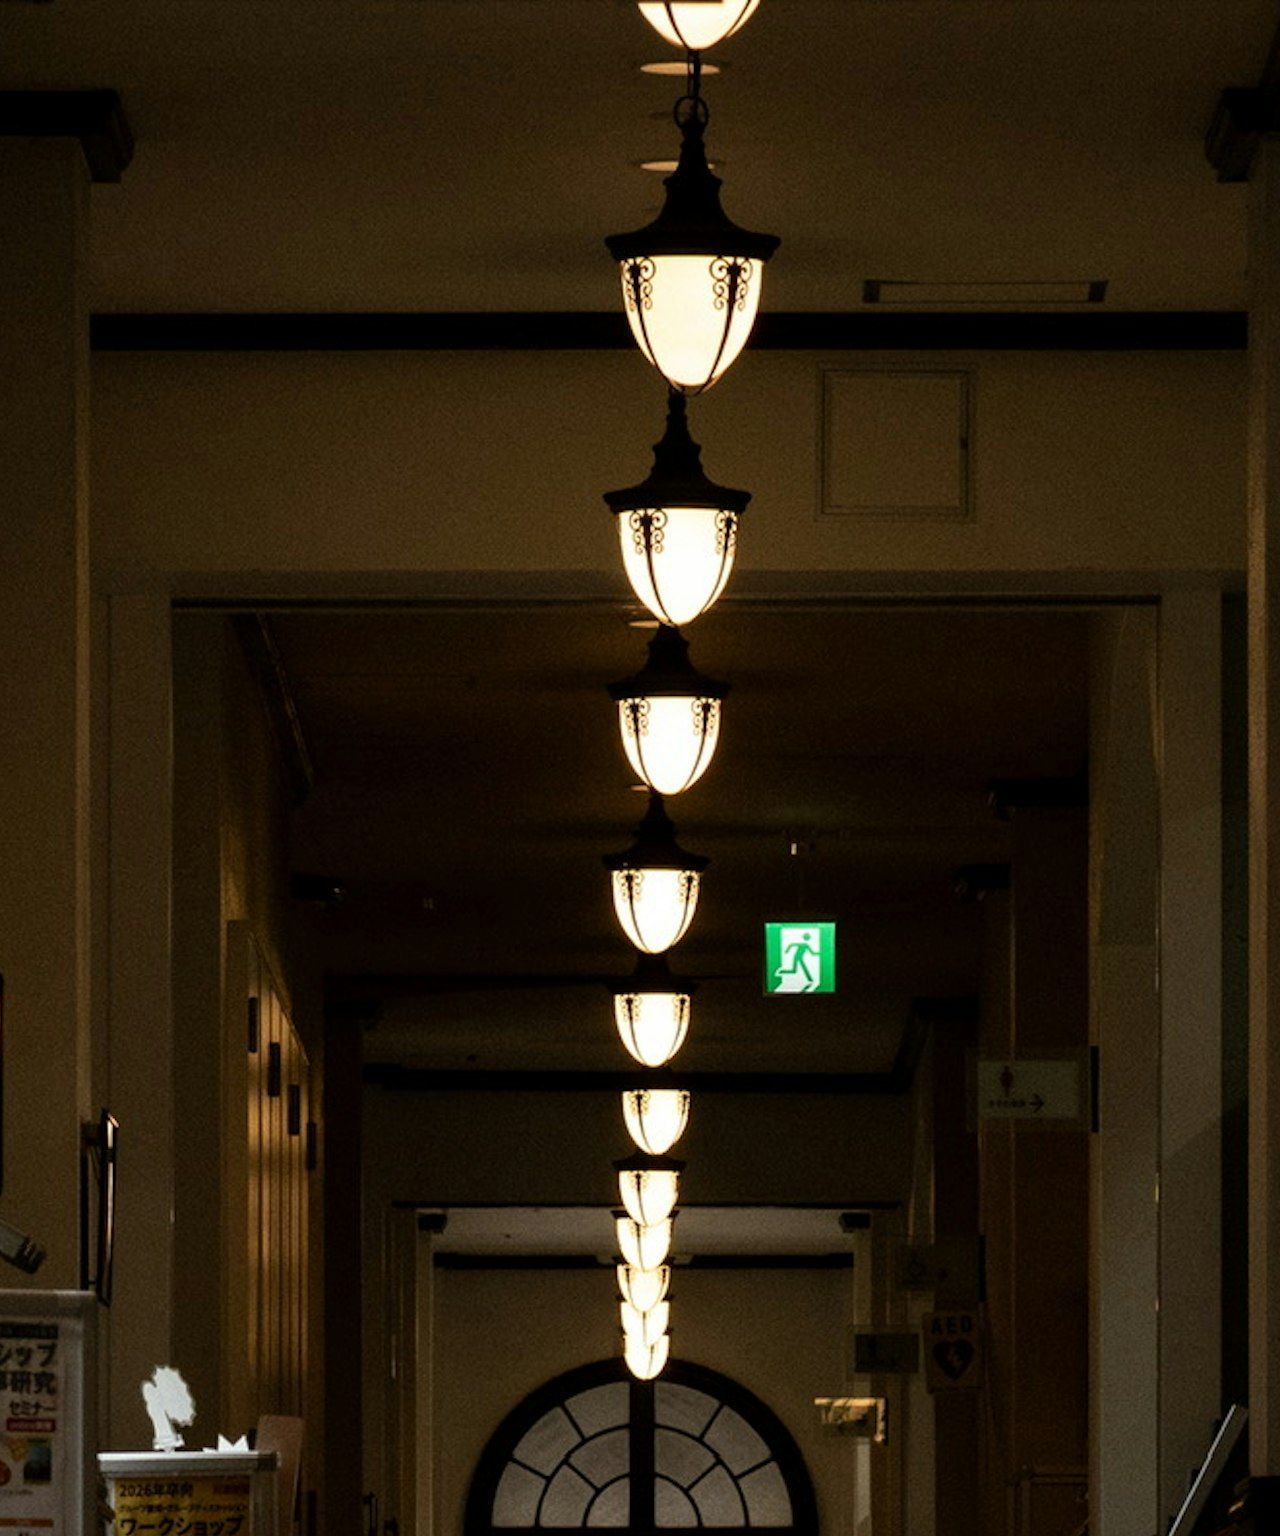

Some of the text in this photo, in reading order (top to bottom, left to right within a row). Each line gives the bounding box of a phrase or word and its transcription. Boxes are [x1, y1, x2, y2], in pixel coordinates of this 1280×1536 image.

[931, 1315, 972, 1335] AED
[9, 1400, 56, 1416] セミナー
[120, 1515, 245, 1536] ワークショップ
